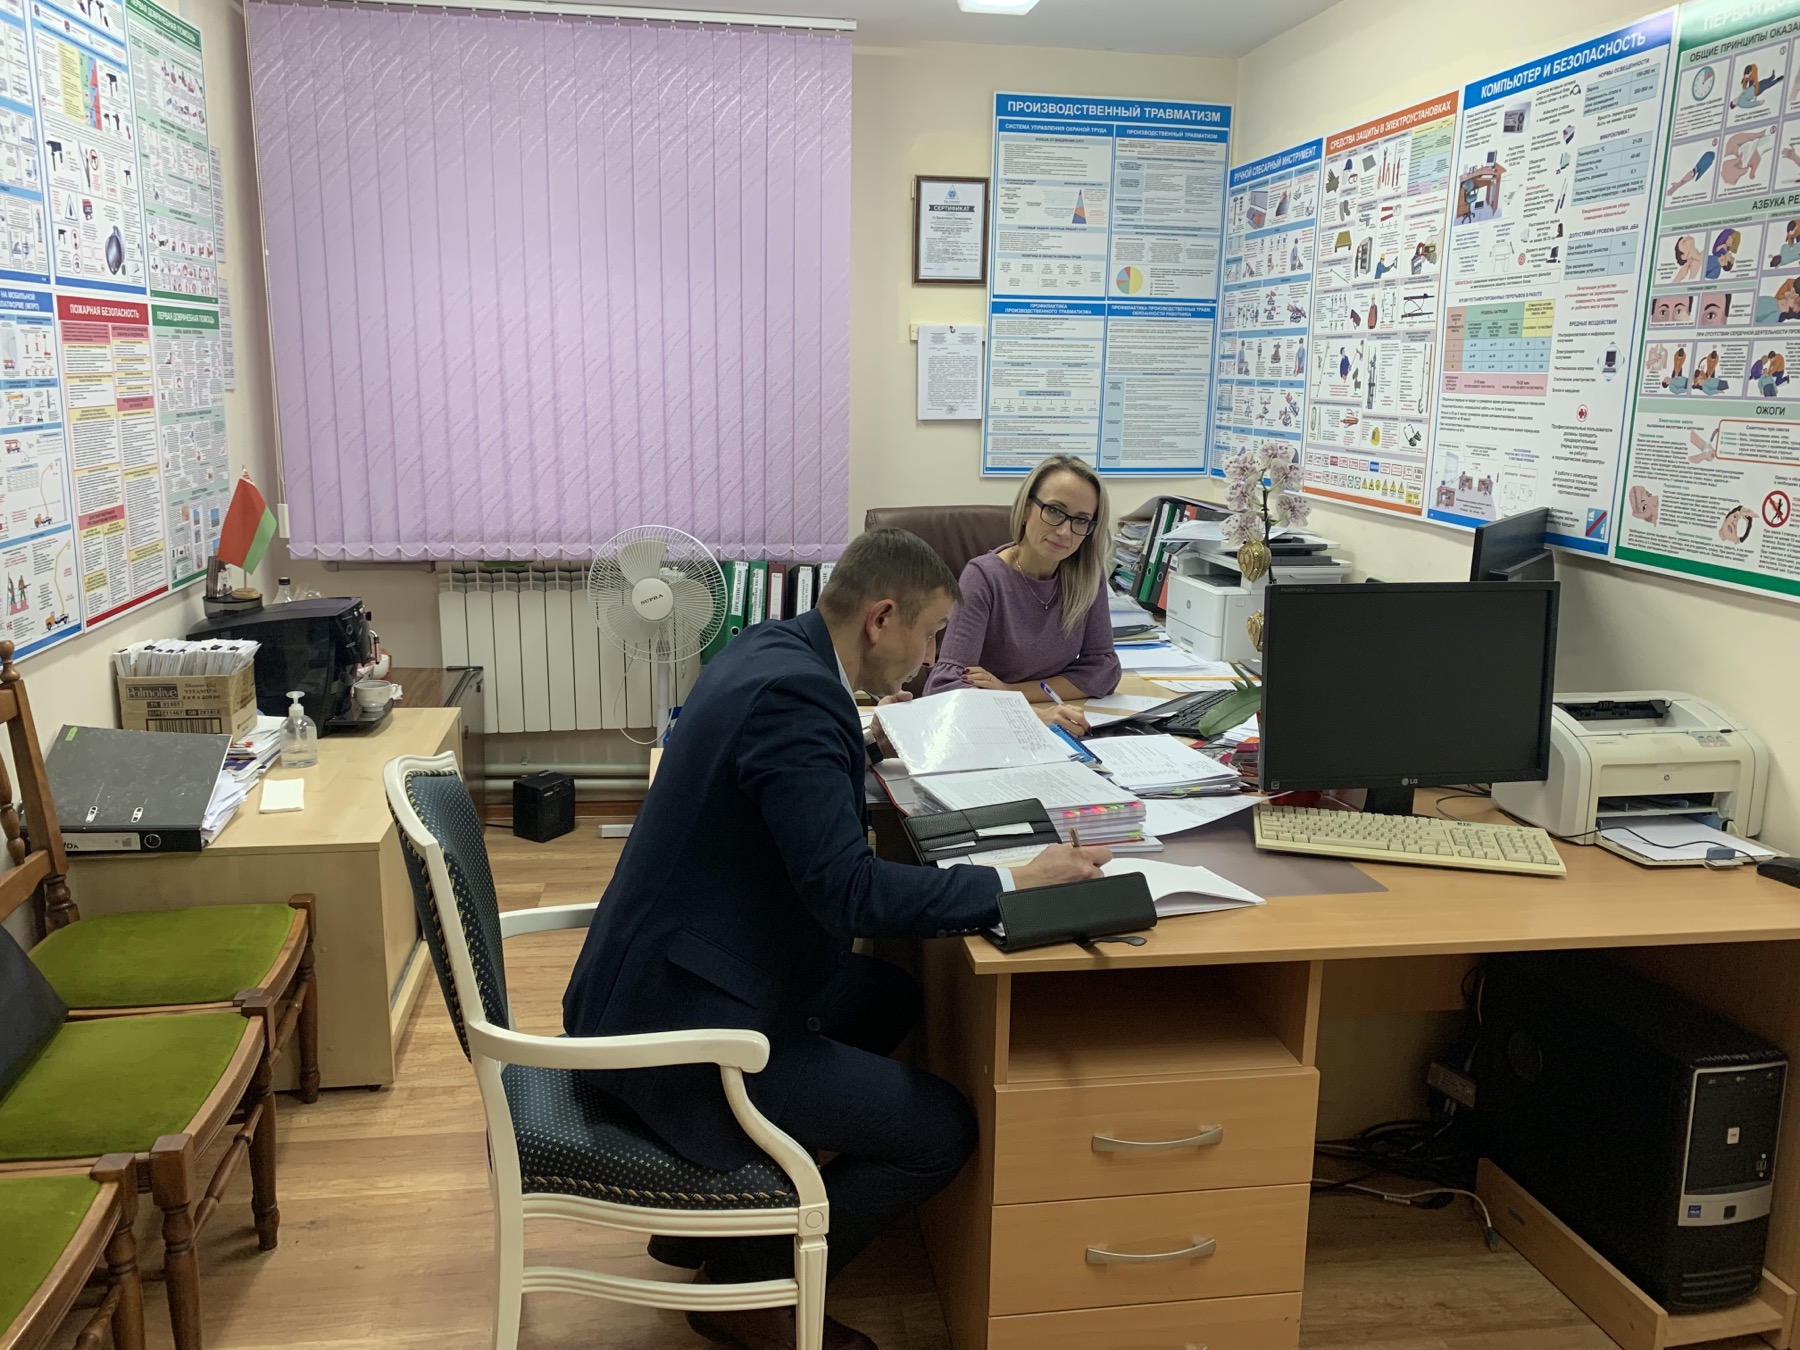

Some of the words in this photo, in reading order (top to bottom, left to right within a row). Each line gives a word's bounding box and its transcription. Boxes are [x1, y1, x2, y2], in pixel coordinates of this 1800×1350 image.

[1690, 45, 1719, 63] ОБЩИЕ
[1720, 32, 1768, 54] ПРИНЦИПЫ
[1480, 68, 1542, 99] КОМПЬЮТЕР
[1543, 63, 1552, 78] И
[1552, 31, 1646, 75] БЕЗОПАСНОСТЬ
[1007, 101, 1140, 117] ПРОИЗВОДСТВЕННЫЙ
[1144, 107, 1221, 122] ТРАВМАТИЗМ
[1031, 124, 1065, 132] УПРАВЛЕНИЯ
[1329, 135, 1356, 150] СРЕДСТВА
[1356, 125, 1380, 143] ЗАЩИТЫ
[1380, 123, 1386, 134] В
[1385, 99, 1452, 133] ЭЛЕКТРОУСТАНОВКАХ
[1126, 129, 1184, 138] ПРОИЗВОДСТВЕННЫЙ
[1233, 167, 1251, 182] РУЧНОЙ
[1252, 157, 1280, 176] СЛЕСАРНЫЙ
[1281, 145, 1317, 168] ИНСТРУМЕНТ
[1751, 198, 1786, 211] АЗБУКА
[1788, 194, 1800, 205] РЕ
[69, 303, 101, 315] ПОЖАРНАЯ
[101, 306, 140, 319] БЕЗОПАСНОСТЬ
[157, 310, 173, 320] ПЕРВАЯ
[173, 312, 199, 322] ДОВРАЧЕБНАЯ
[199, 314, 215, 324] ПОМОЩЬ
[1755, 405, 1786, 416] ОЖОГИ
[734, 570, 743, 612] ПРЕДПИСАНИЯ
[640, 594, 664, 605] SUPRA
[126, 686, 178, 699] Palmolive
